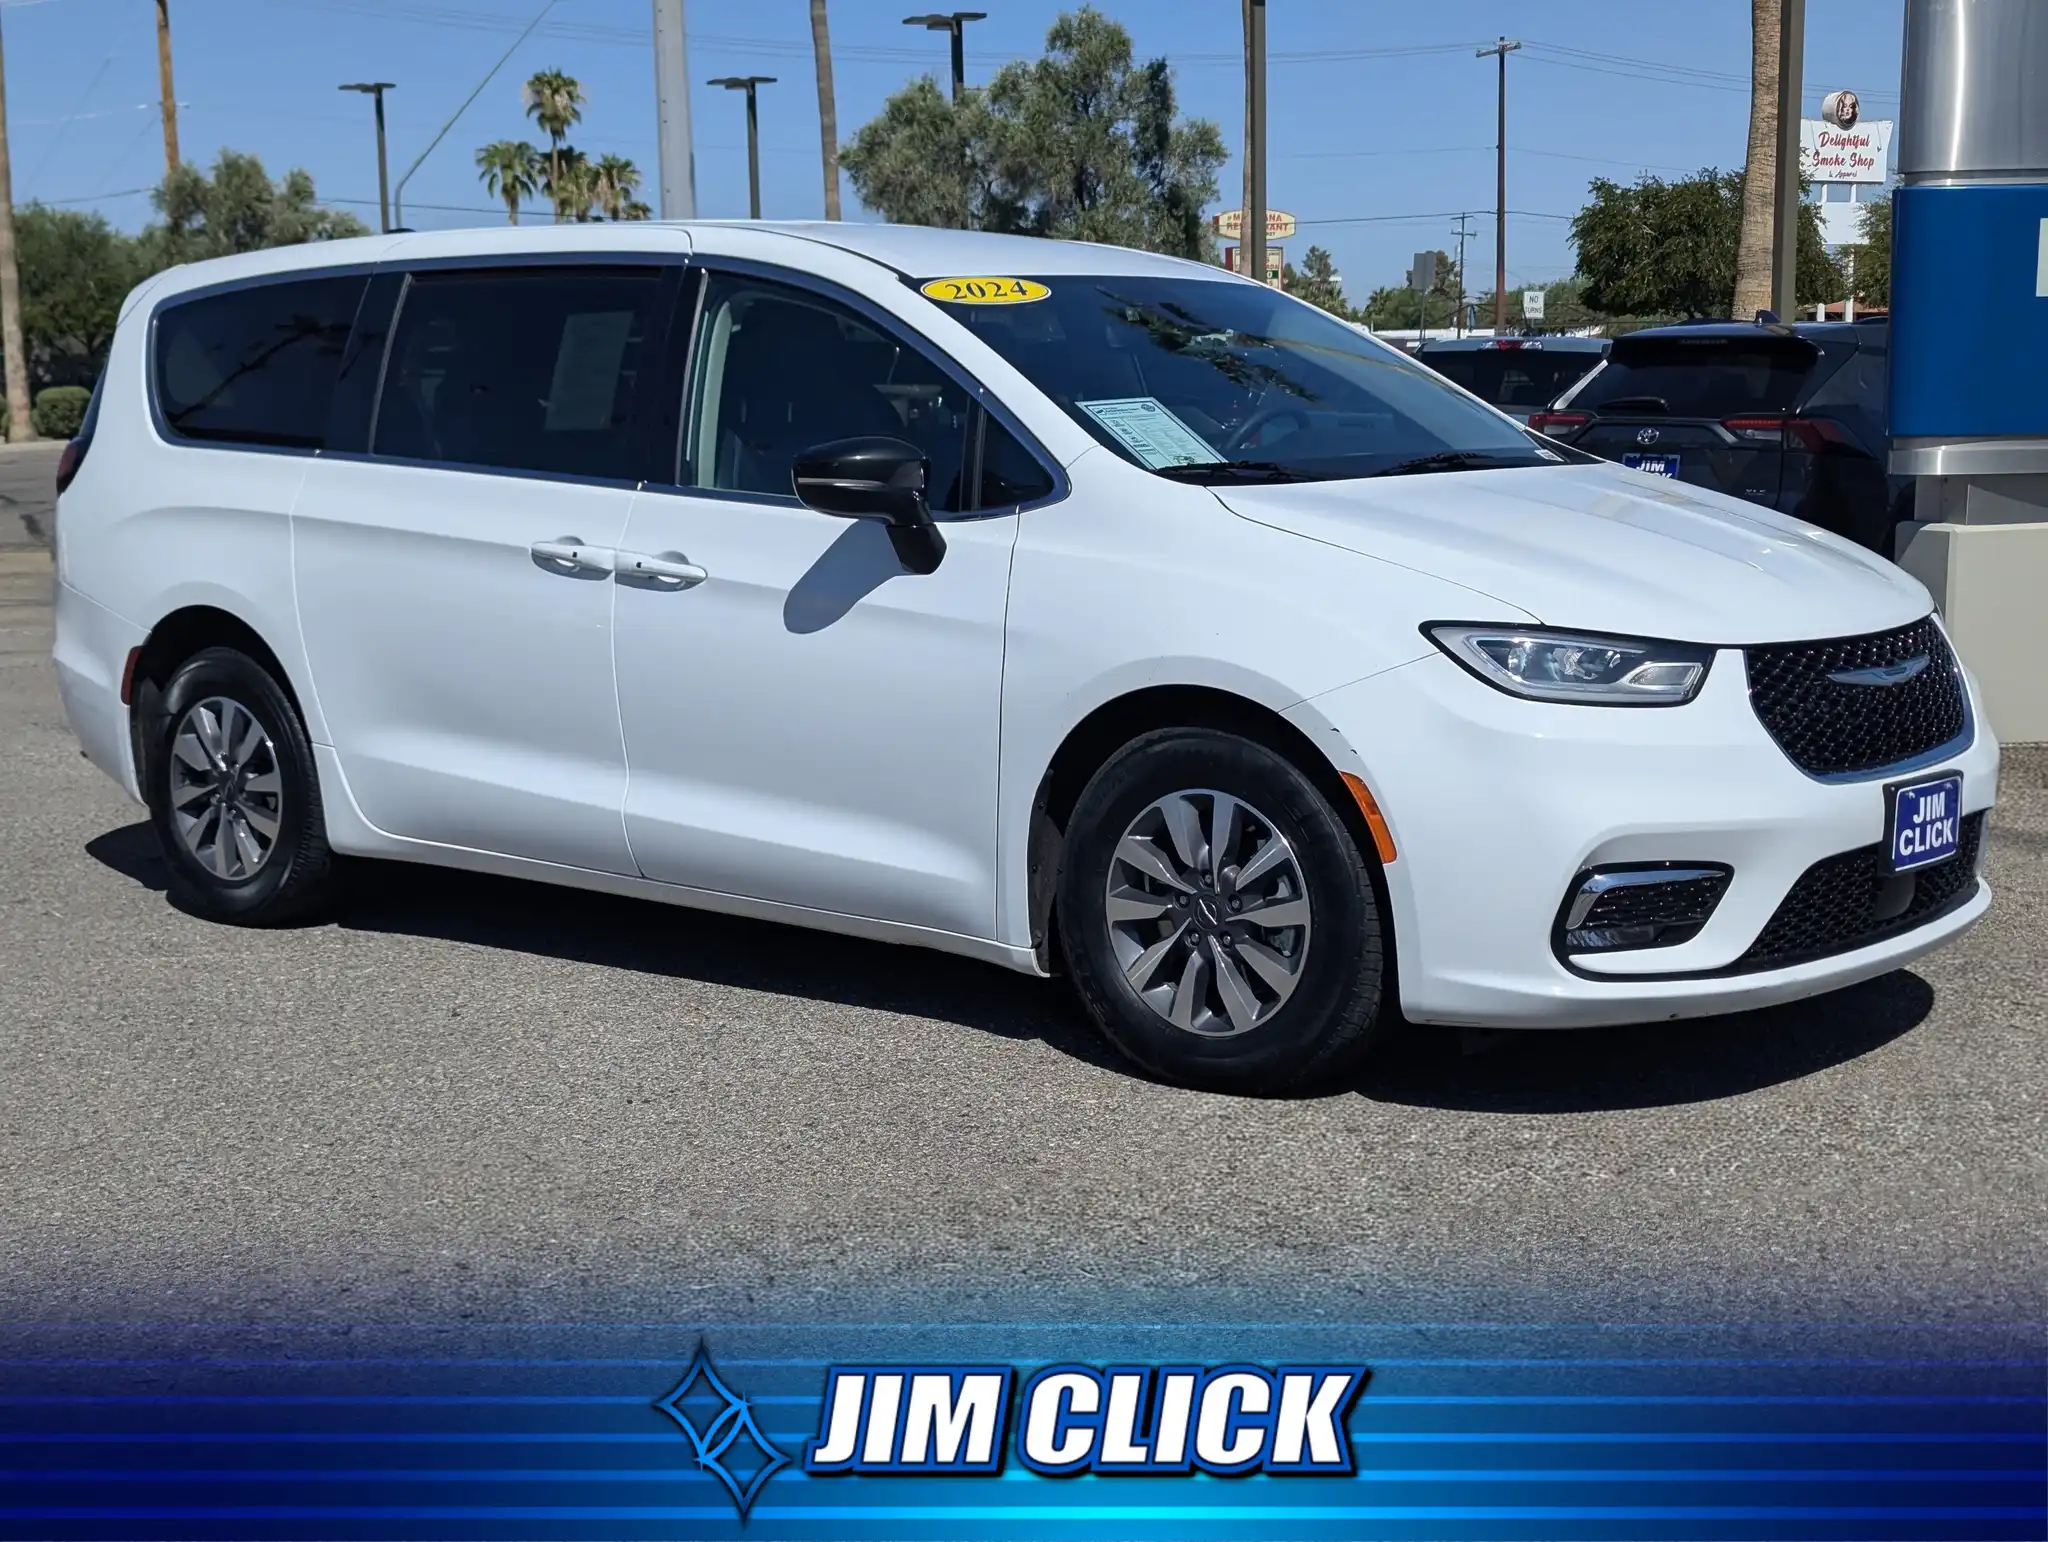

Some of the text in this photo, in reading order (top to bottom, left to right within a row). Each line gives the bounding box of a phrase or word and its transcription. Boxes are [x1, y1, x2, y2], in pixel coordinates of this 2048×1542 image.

[1819, 131, 1870, 151] Delightful
[1812, 149, 1875, 171] Smoke Shop
[944, 280, 1028, 300] 2024
[1529, 295, 1539, 304] NO
[1525, 306, 1542, 314] TURNS
[1635, 460, 1666, 472] JIM
[1912, 791, 1946, 824] JIM
[1899, 817, 1954, 857] CLICK
